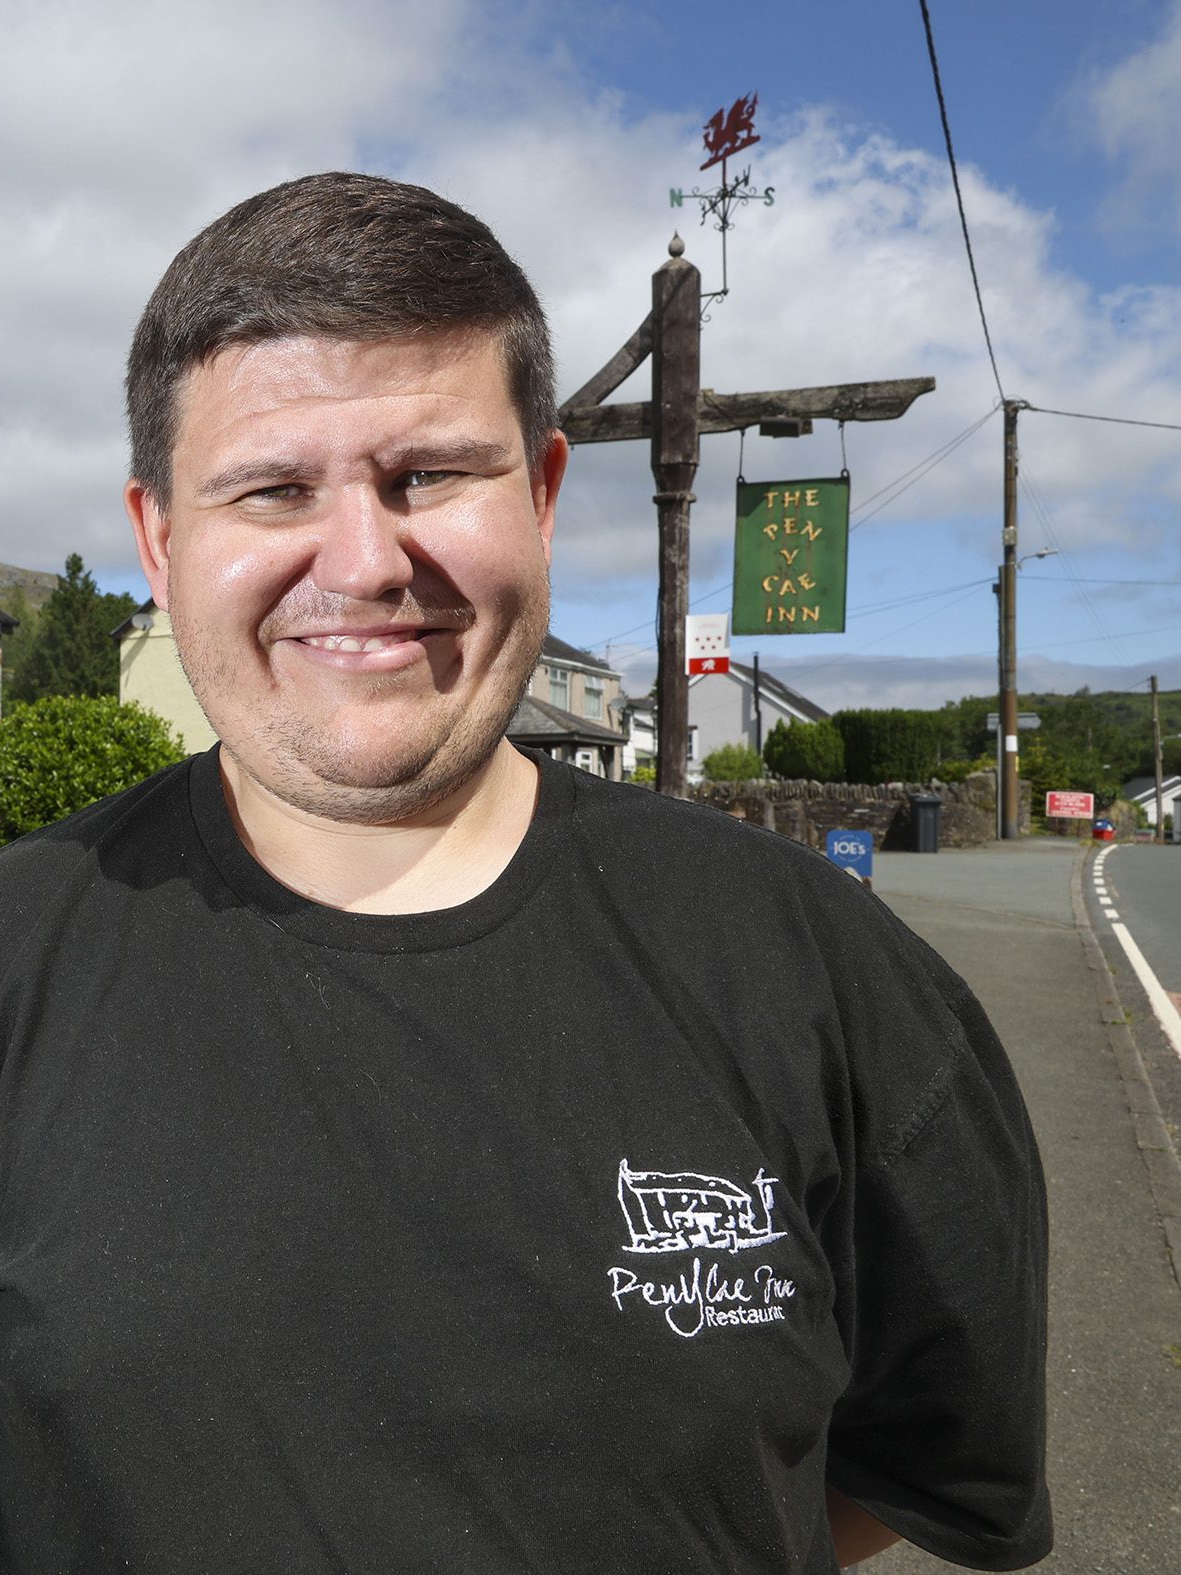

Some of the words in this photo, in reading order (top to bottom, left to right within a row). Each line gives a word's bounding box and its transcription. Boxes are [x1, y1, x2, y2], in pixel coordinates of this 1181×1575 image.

[669, 188, 683, 208] N
[763, 186, 776, 207] S
[763, 489, 820, 508] THE
[762, 517, 823, 541] PEN
[780, 549, 800, 565] Y
[762, 572, 817, 596] CAE
[766, 605, 820, 623] INN
